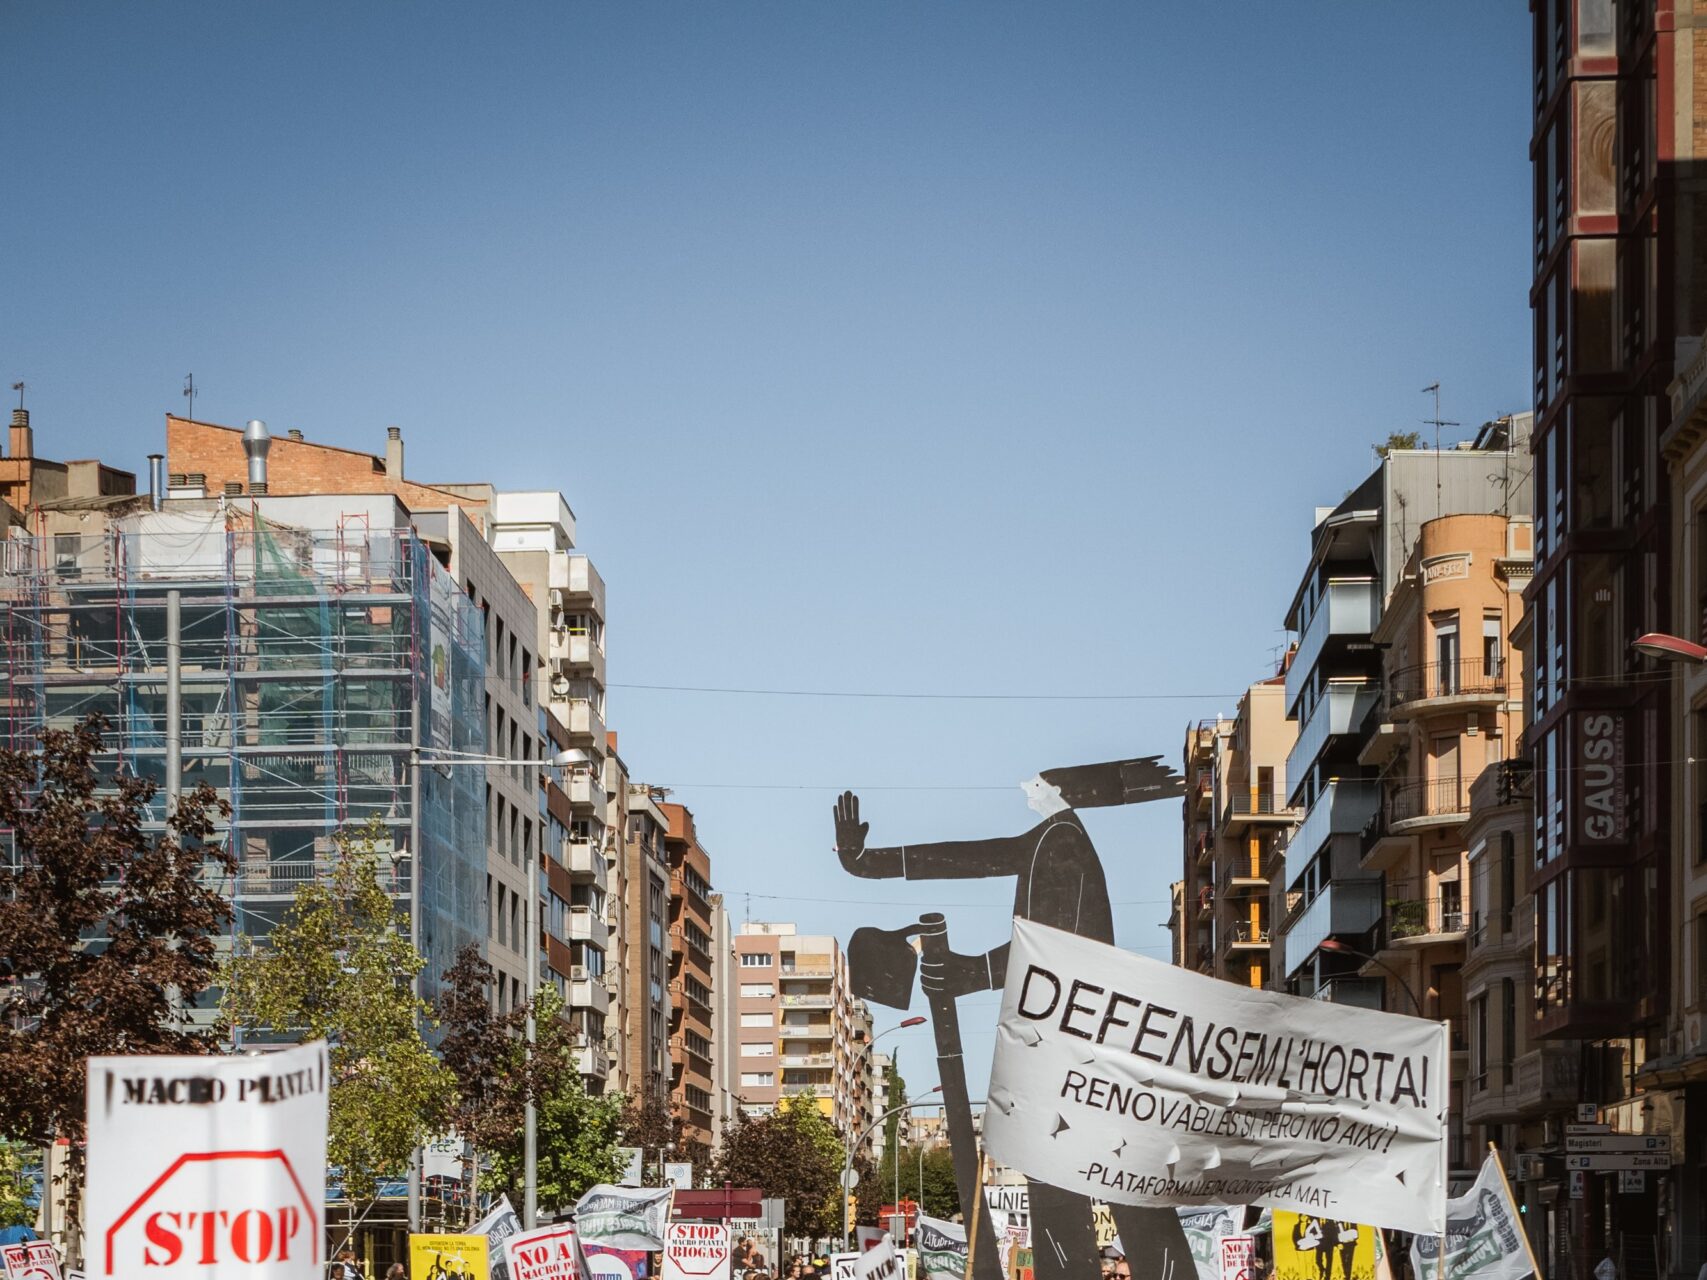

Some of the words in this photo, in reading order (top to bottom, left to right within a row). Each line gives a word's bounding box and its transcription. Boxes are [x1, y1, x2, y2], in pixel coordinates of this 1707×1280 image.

[1584, 715, 1614, 840] GAUSS
[1017, 963, 1284, 1086] DEFENSEM
[1277, 1036, 1429, 1109] L'HORTA!
[1061, 1069, 1240, 1139] RENOVABLES
[1305, 1116, 1341, 1142] NO
[430, 1143, 451, 1153] FCC
[1568, 1137, 1602, 1149] Magisteri
[1633, 1157, 1651, 1166] Zona
[1653, 1156, 1668, 1166] Alta
[1273, 1181, 1292, 1199] LA
[989, 1187, 1029, 1210] LÍNIE
[677, 1225, 720, 1239] STOP
[743, 1221, 757, 1230] THE
[144, 1205, 299, 1267] STOP
[9, 1251, 25, 1264] NO
[38, 1248, 52, 1260] LA
[519, 1244, 549, 1270] NO
[556, 1242, 571, 1262] A
[673, 1246, 722, 1259] BIOGAS
[1225, 1243, 1242, 1254] NO
[1227, 1260, 1240, 1268] DE
